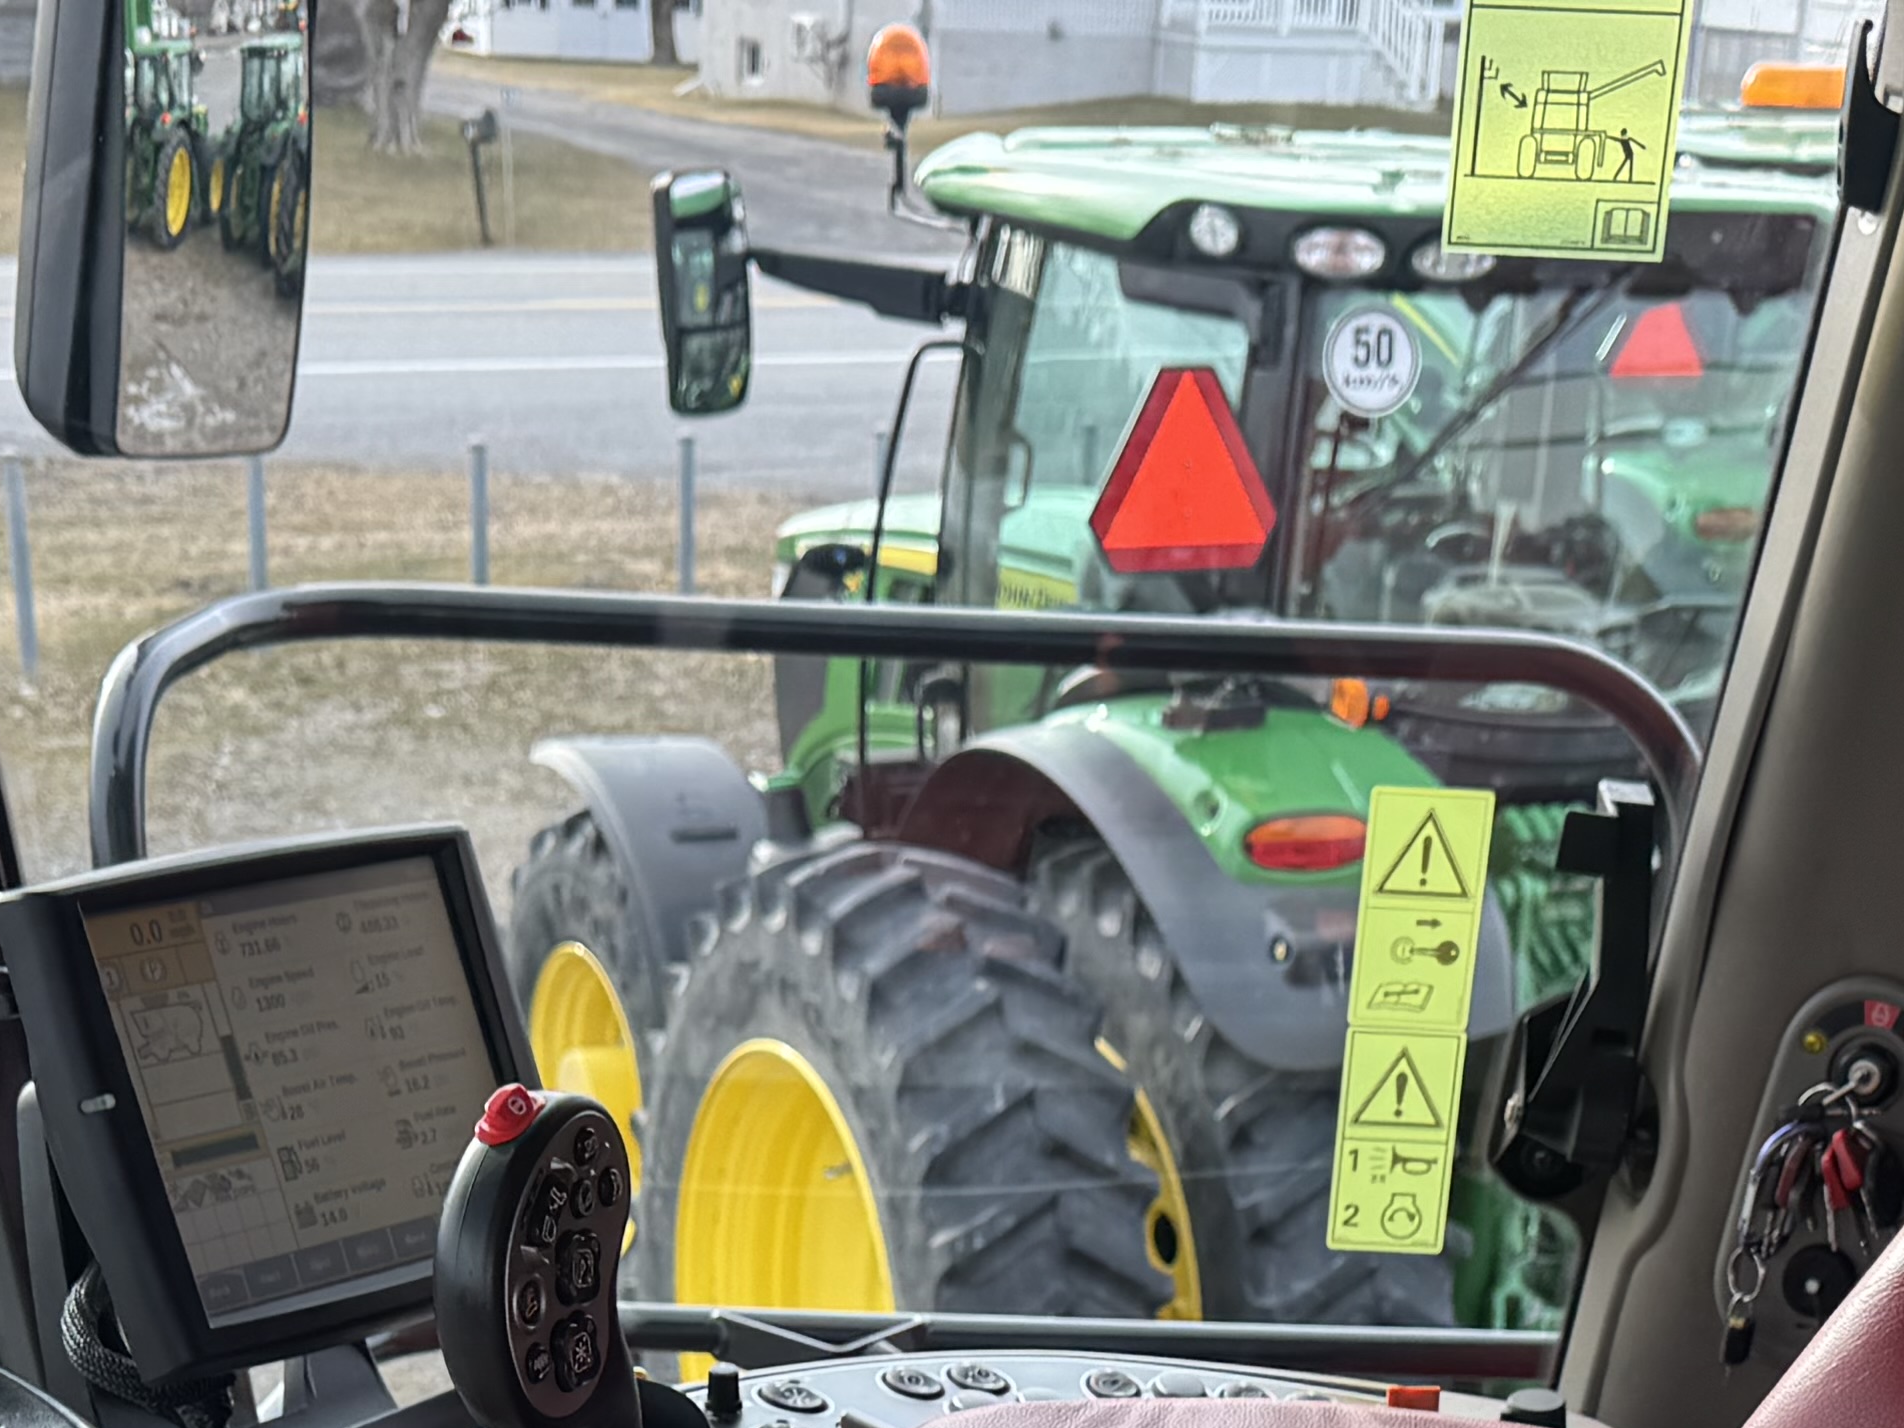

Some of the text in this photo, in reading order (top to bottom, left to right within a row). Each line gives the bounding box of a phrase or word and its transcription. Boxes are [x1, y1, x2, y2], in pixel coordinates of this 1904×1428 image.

[1353, 326, 1393, 369] 50
[129, 918, 162, 946] 0.0
[1348, 1148, 1359, 1172] 1
[1342, 1204, 1359, 1227] 2
